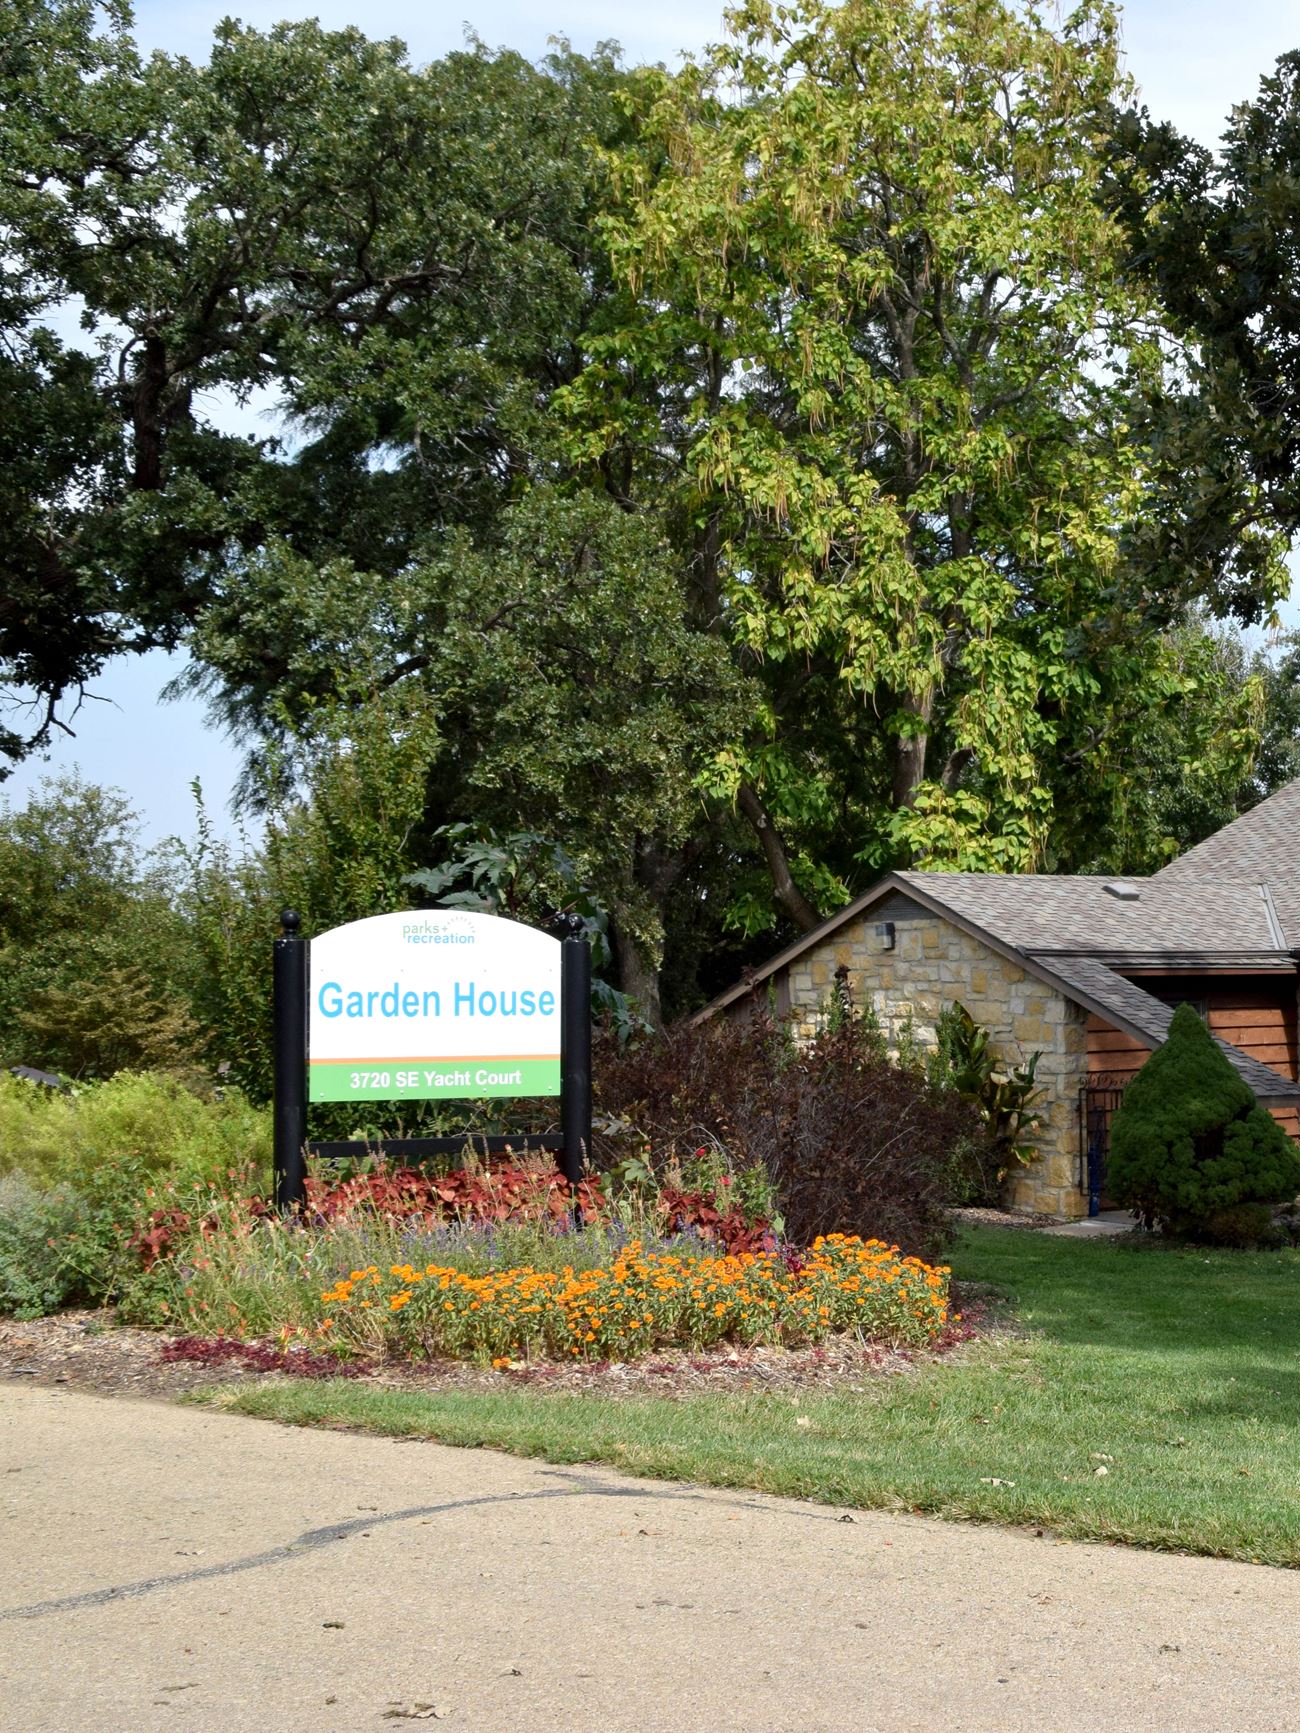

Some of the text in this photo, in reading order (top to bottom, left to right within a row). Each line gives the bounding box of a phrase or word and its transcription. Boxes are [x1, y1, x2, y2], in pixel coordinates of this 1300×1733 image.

[403, 920, 439, 938] parks
[407, 933, 475, 944] recreation
[318, 982, 555, 1018] Garden House
[350, 1069, 522, 1089] 3720 SE Yacht Court
